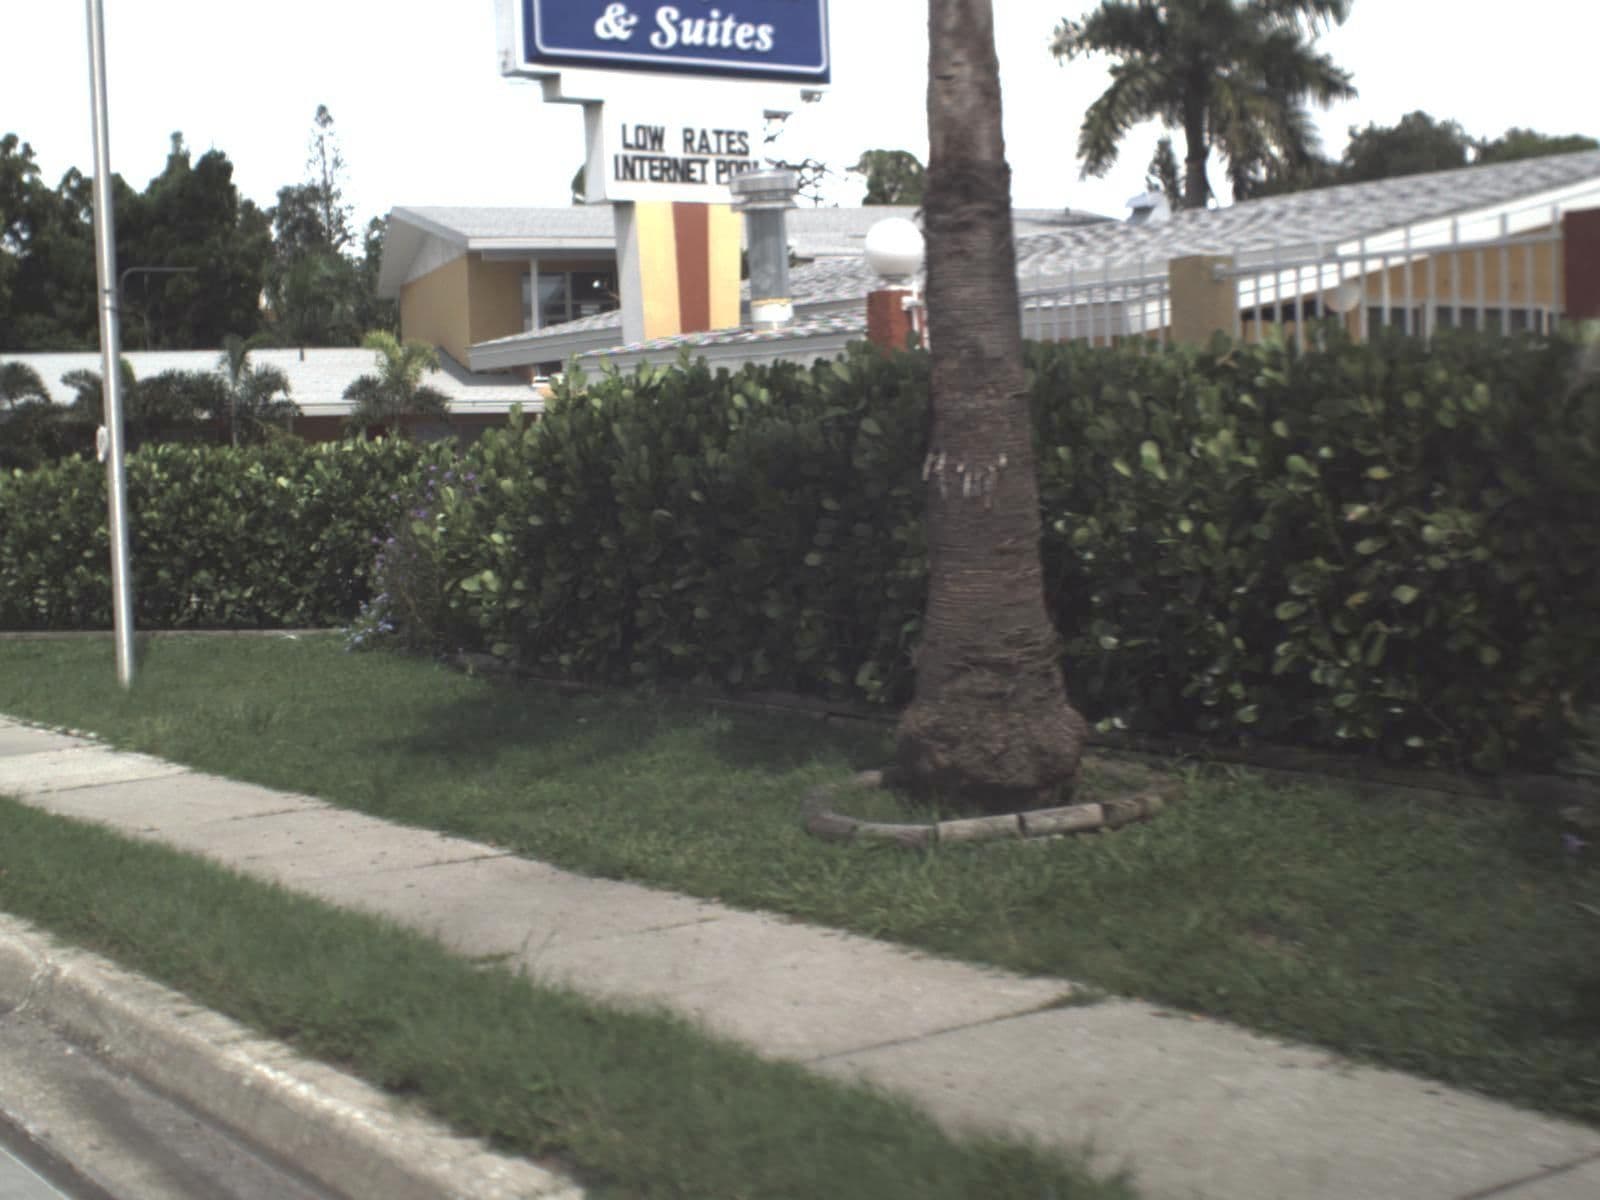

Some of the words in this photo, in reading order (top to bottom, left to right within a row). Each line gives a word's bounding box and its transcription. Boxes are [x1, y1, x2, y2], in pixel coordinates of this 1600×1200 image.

[594, 2, 638, 40] &
[649, 5, 774, 51] Suites
[621, 123, 665, 152] LOW
[682, 127, 750, 156] RATES
[614, 154, 709, 184] INTERNET
